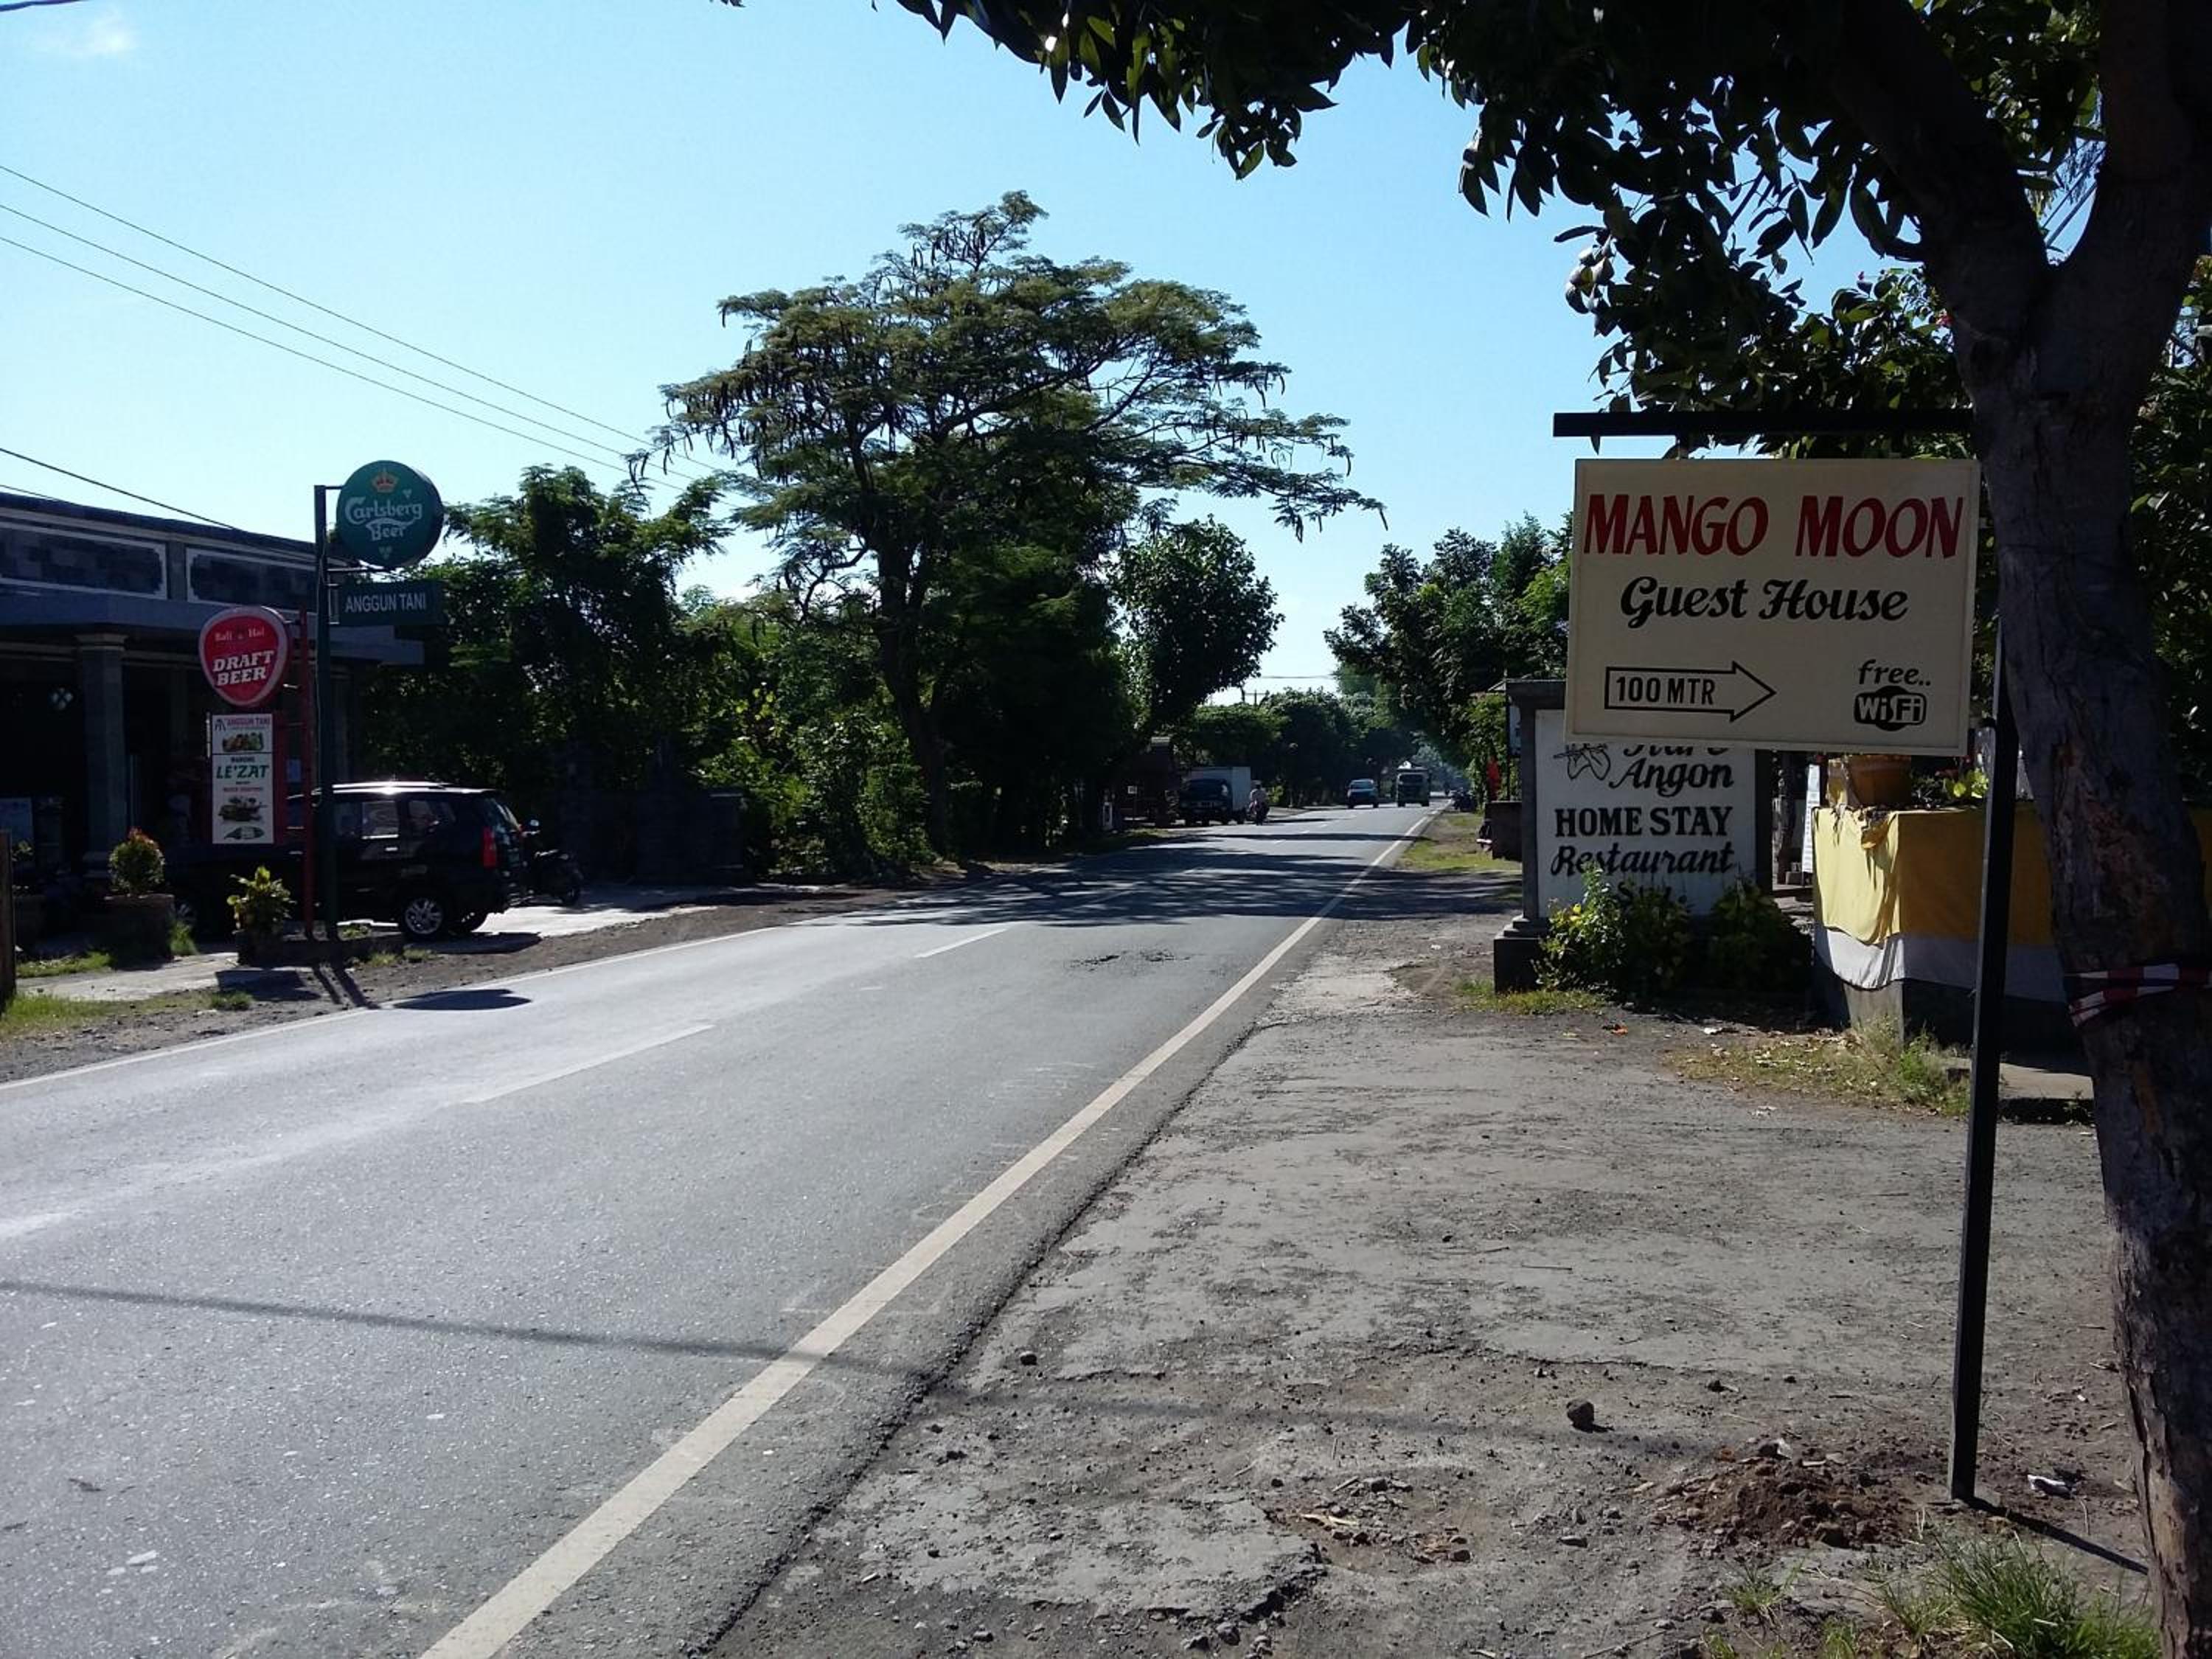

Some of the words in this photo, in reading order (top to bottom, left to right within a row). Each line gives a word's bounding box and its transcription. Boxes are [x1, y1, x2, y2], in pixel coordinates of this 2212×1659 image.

[344, 496, 422, 525] Carlsberg
[366, 518, 408, 541] Beer
[1583, 494, 1769, 557] MANGO
[1795, 495, 1964, 559] MOON
[345, 594, 397, 613] ANGGUN
[399, 592, 425, 611] TANI
[1621, 575, 1748, 628] Guest
[1759, 579, 1909, 621] House
[213, 650, 274, 672] DRAFT
[217, 666, 266, 686] BEER
[1615, 676, 1660, 703] 100
[1667, 677, 1715, 705] MTR
[216, 765, 270, 779] LE'ZAT
[1609, 757, 1734, 798] Angon
[1554, 807, 1643, 838] HOME
[1650, 806, 1733, 836] STAY
[1551, 841, 1734, 877] Restaurant
